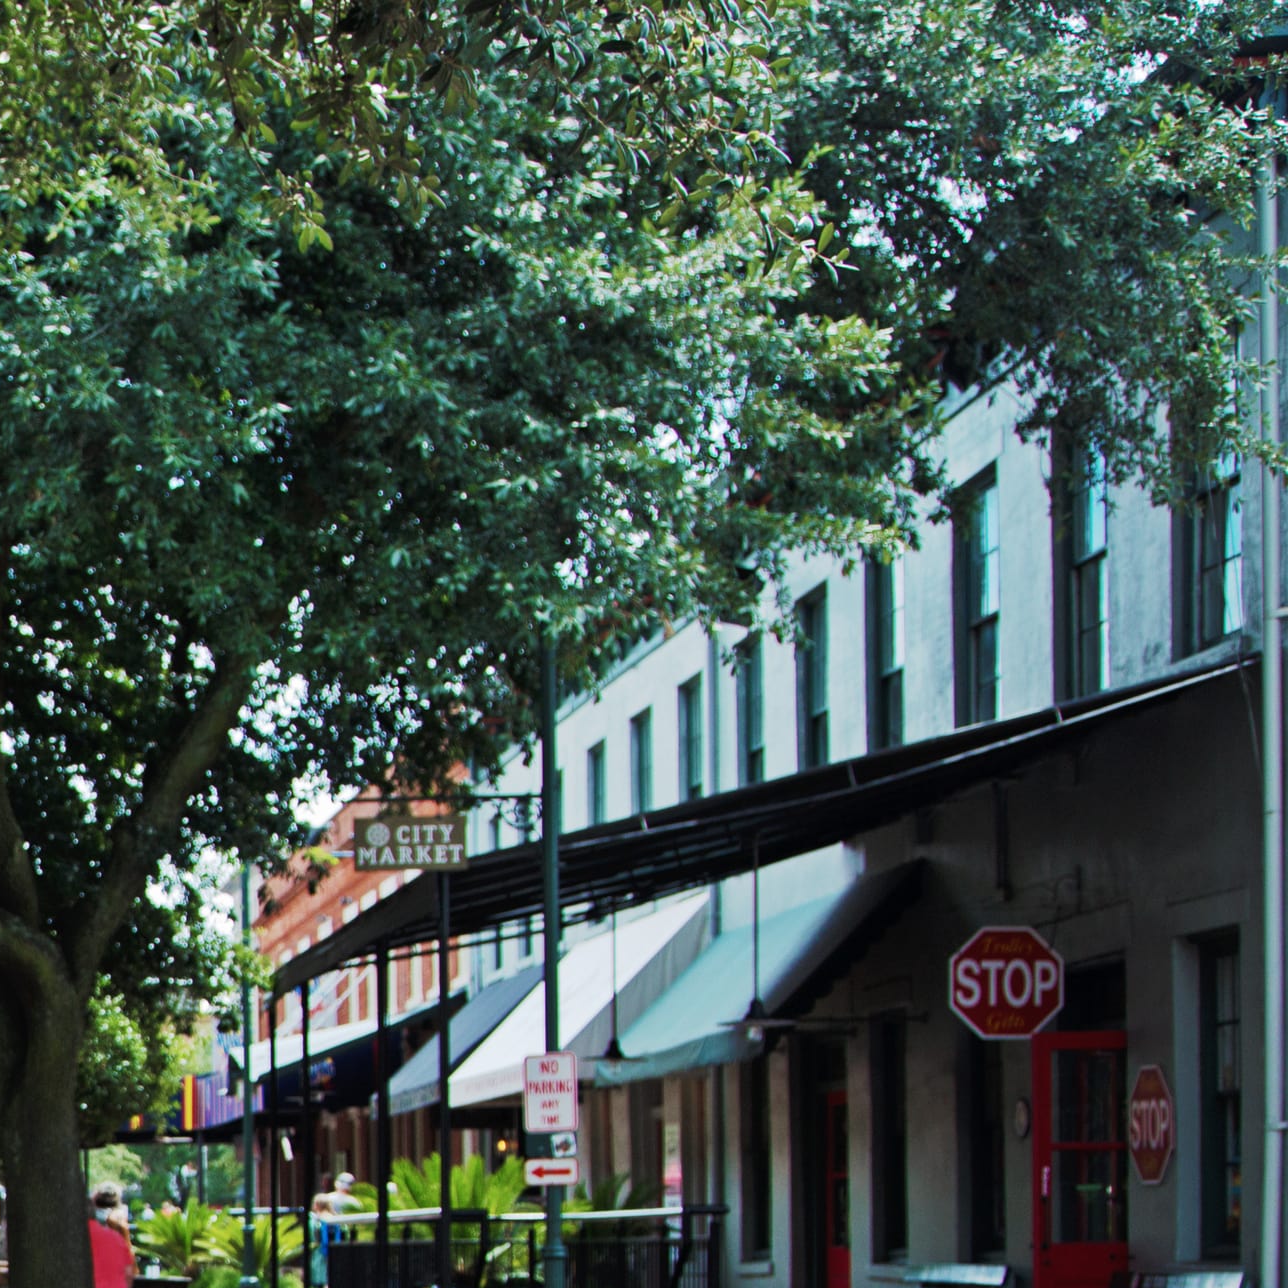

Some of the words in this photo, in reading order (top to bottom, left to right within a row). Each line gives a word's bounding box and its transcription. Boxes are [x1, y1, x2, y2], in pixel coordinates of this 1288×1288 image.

[396, 824, 454, 844] CITY
[357, 844, 464, 866] MARKET
[956, 959, 1058, 1008] STOP
[540, 1060, 559, 1075] NO
[529, 1080, 573, 1095] PARKING
[541, 1099, 560, 1111] ANY
[1130, 1098, 1170, 1151] STOP
